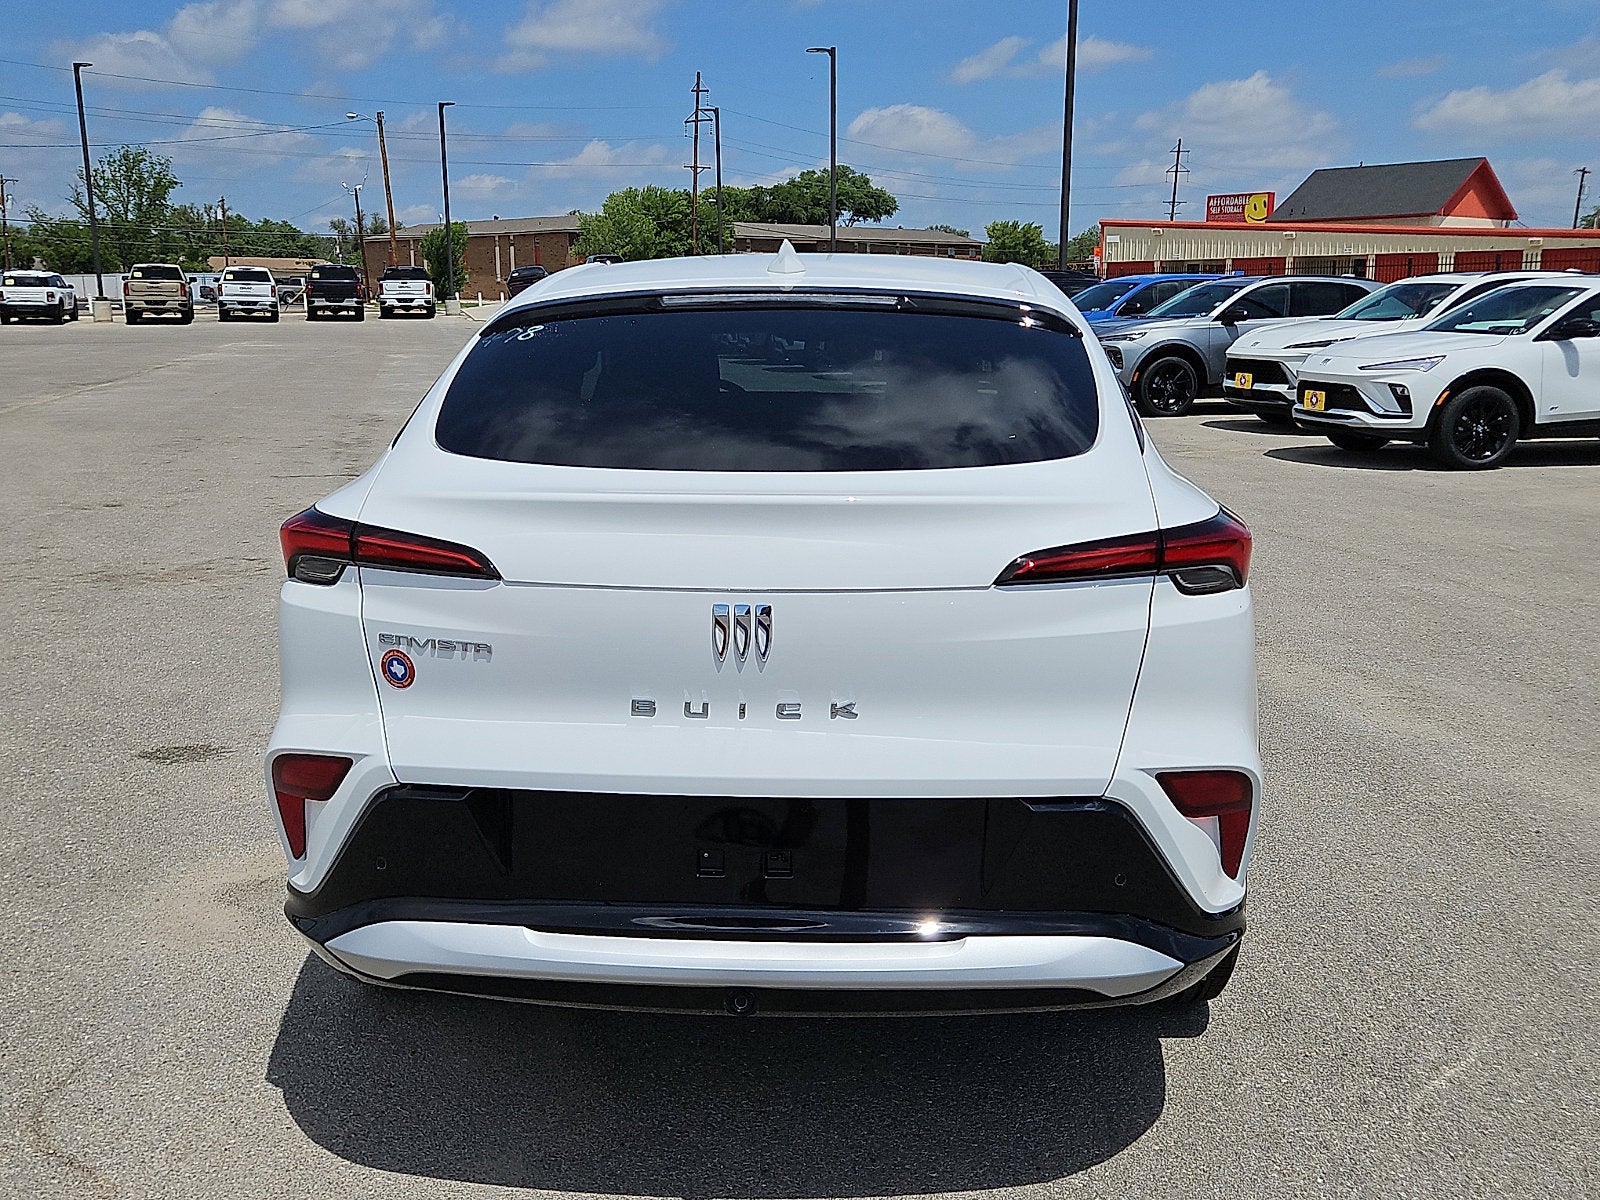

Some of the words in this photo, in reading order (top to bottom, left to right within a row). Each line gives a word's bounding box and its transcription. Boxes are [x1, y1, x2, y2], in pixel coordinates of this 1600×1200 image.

[1209, 196, 1249, 206] AFFORDABLE
[1210, 205, 1221, 214] SELF
[1221, 205, 1243, 214] STORAGE
[378, 633, 493, 654] ENVISTA
[630, 699, 860, 720] BUICK
